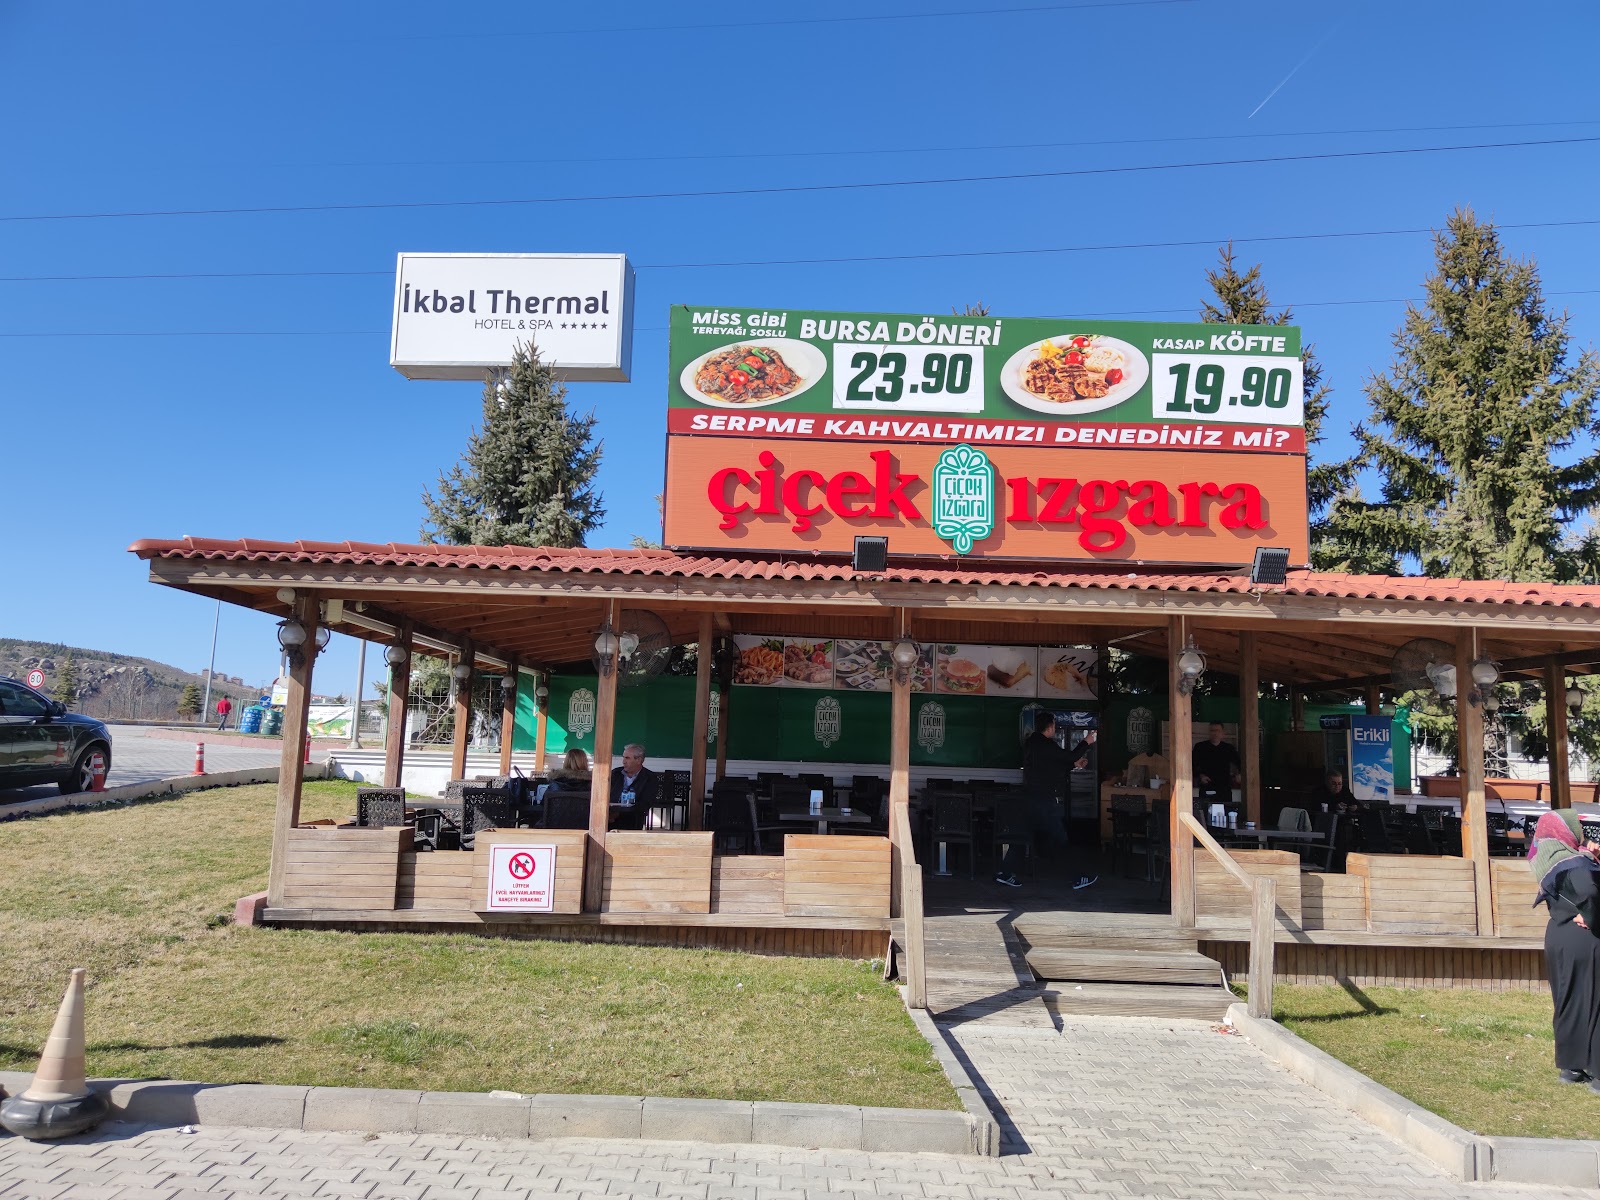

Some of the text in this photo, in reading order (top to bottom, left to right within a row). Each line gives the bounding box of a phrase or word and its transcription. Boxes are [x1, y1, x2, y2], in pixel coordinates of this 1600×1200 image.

[403, 283, 609, 315] İkbal Thermal
[474, 318, 553, 330] HOTEL & SPA
[692, 309, 787, 328] MİSS GİBİ
[692, 326, 787, 338] TEREYAĞI SOSLU
[800, 317, 1002, 346] BURSA DÖNERİ
[1152, 331, 1286, 352] KASAP KÖFTE
[846, 351, 973, 403] 23.90
[1165, 362, 1292, 414] 19.90
[690, 414, 1291, 448] SERPME KAHVALTIMIZI DENEDİNİZ Mİ?
[707, 450, 1269, 553] çiçek ızgara
[30, 674, 42, 683] 80
[1353, 727, 1390, 742] Erikli
